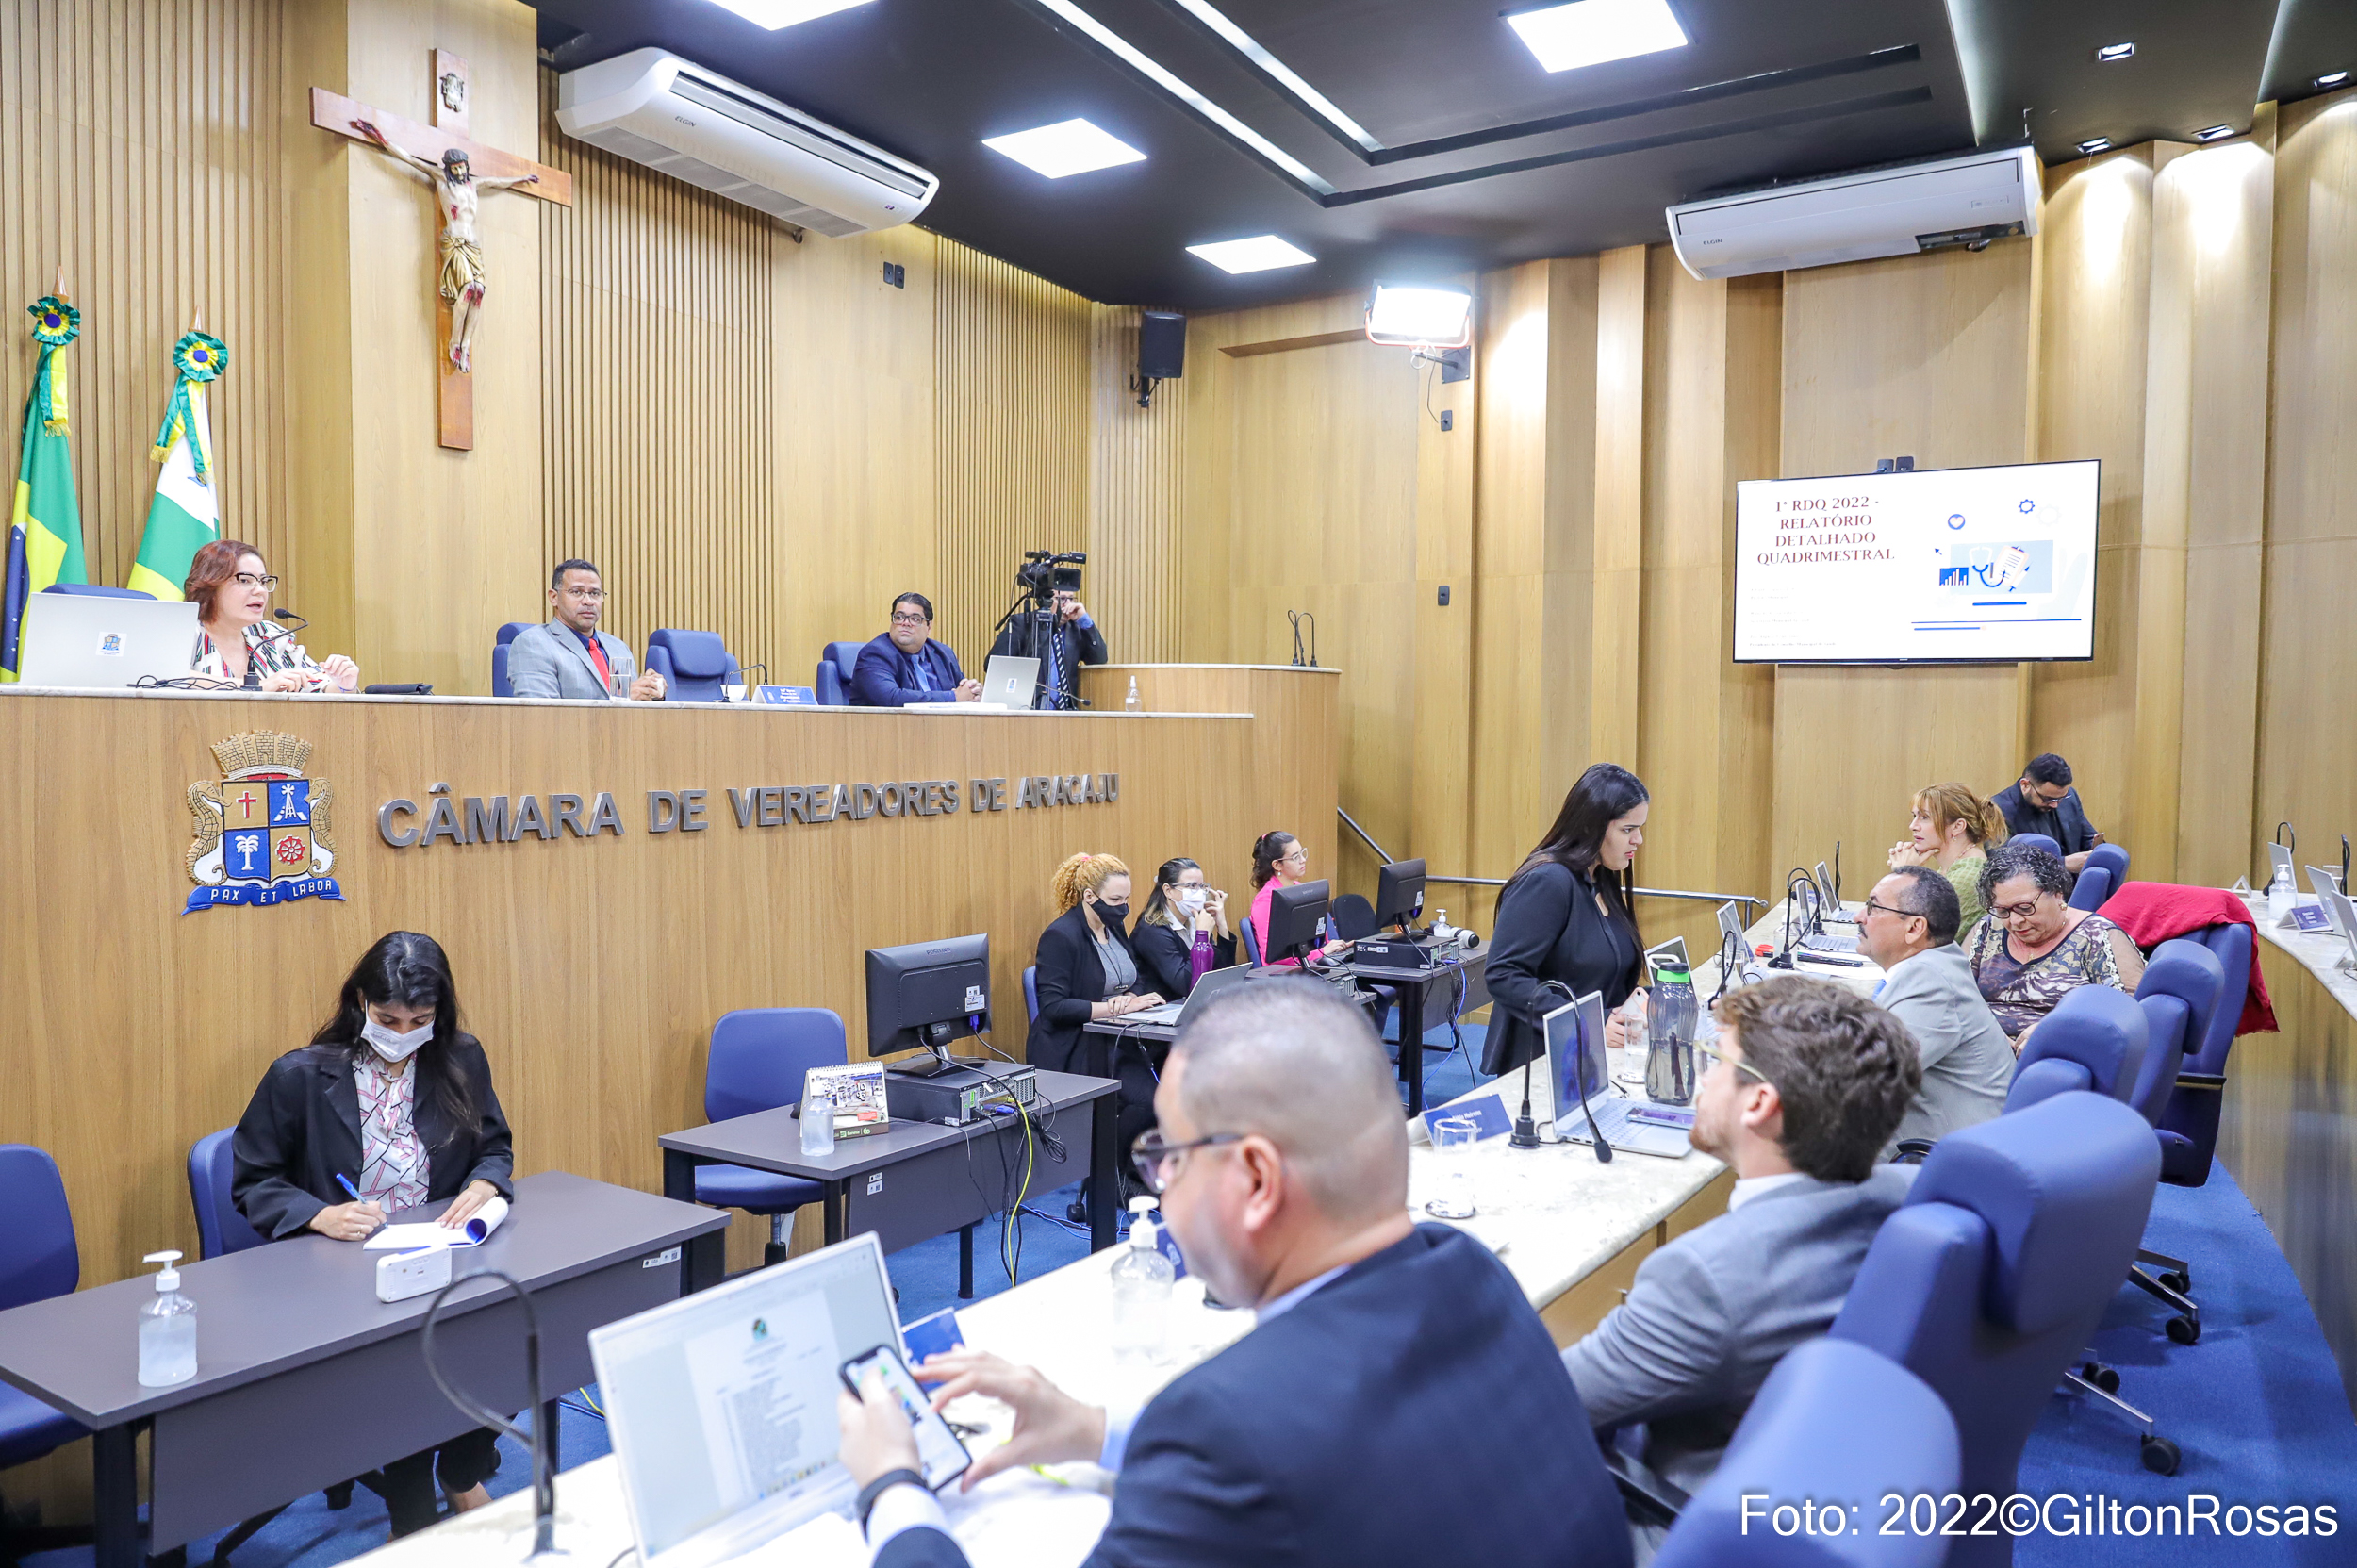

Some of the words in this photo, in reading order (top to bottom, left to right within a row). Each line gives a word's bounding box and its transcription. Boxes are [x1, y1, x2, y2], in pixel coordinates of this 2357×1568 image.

[675, 115, 697, 127] ELGIN
[1792, 499, 1827, 511] RDQ
[1832, 496, 1870, 509] 2022
[1780, 513, 1872, 530] RELATÓRIO
[1775, 531, 1876, 547] DETALHADO
[1757, 548, 1895, 566] QUADRIMESTRAL
[377, 782, 625, 848] CÂMARA
[647, 788, 709, 834] DE
[726, 779, 961, 828] VEREADORES
[970, 777, 1008, 813] DE
[1014, 772, 1120, 809] ARACAJU
[210, 889, 240, 901] PAX
[260, 891, 276, 903] ET
[292, 880, 332, 897] LABOR
